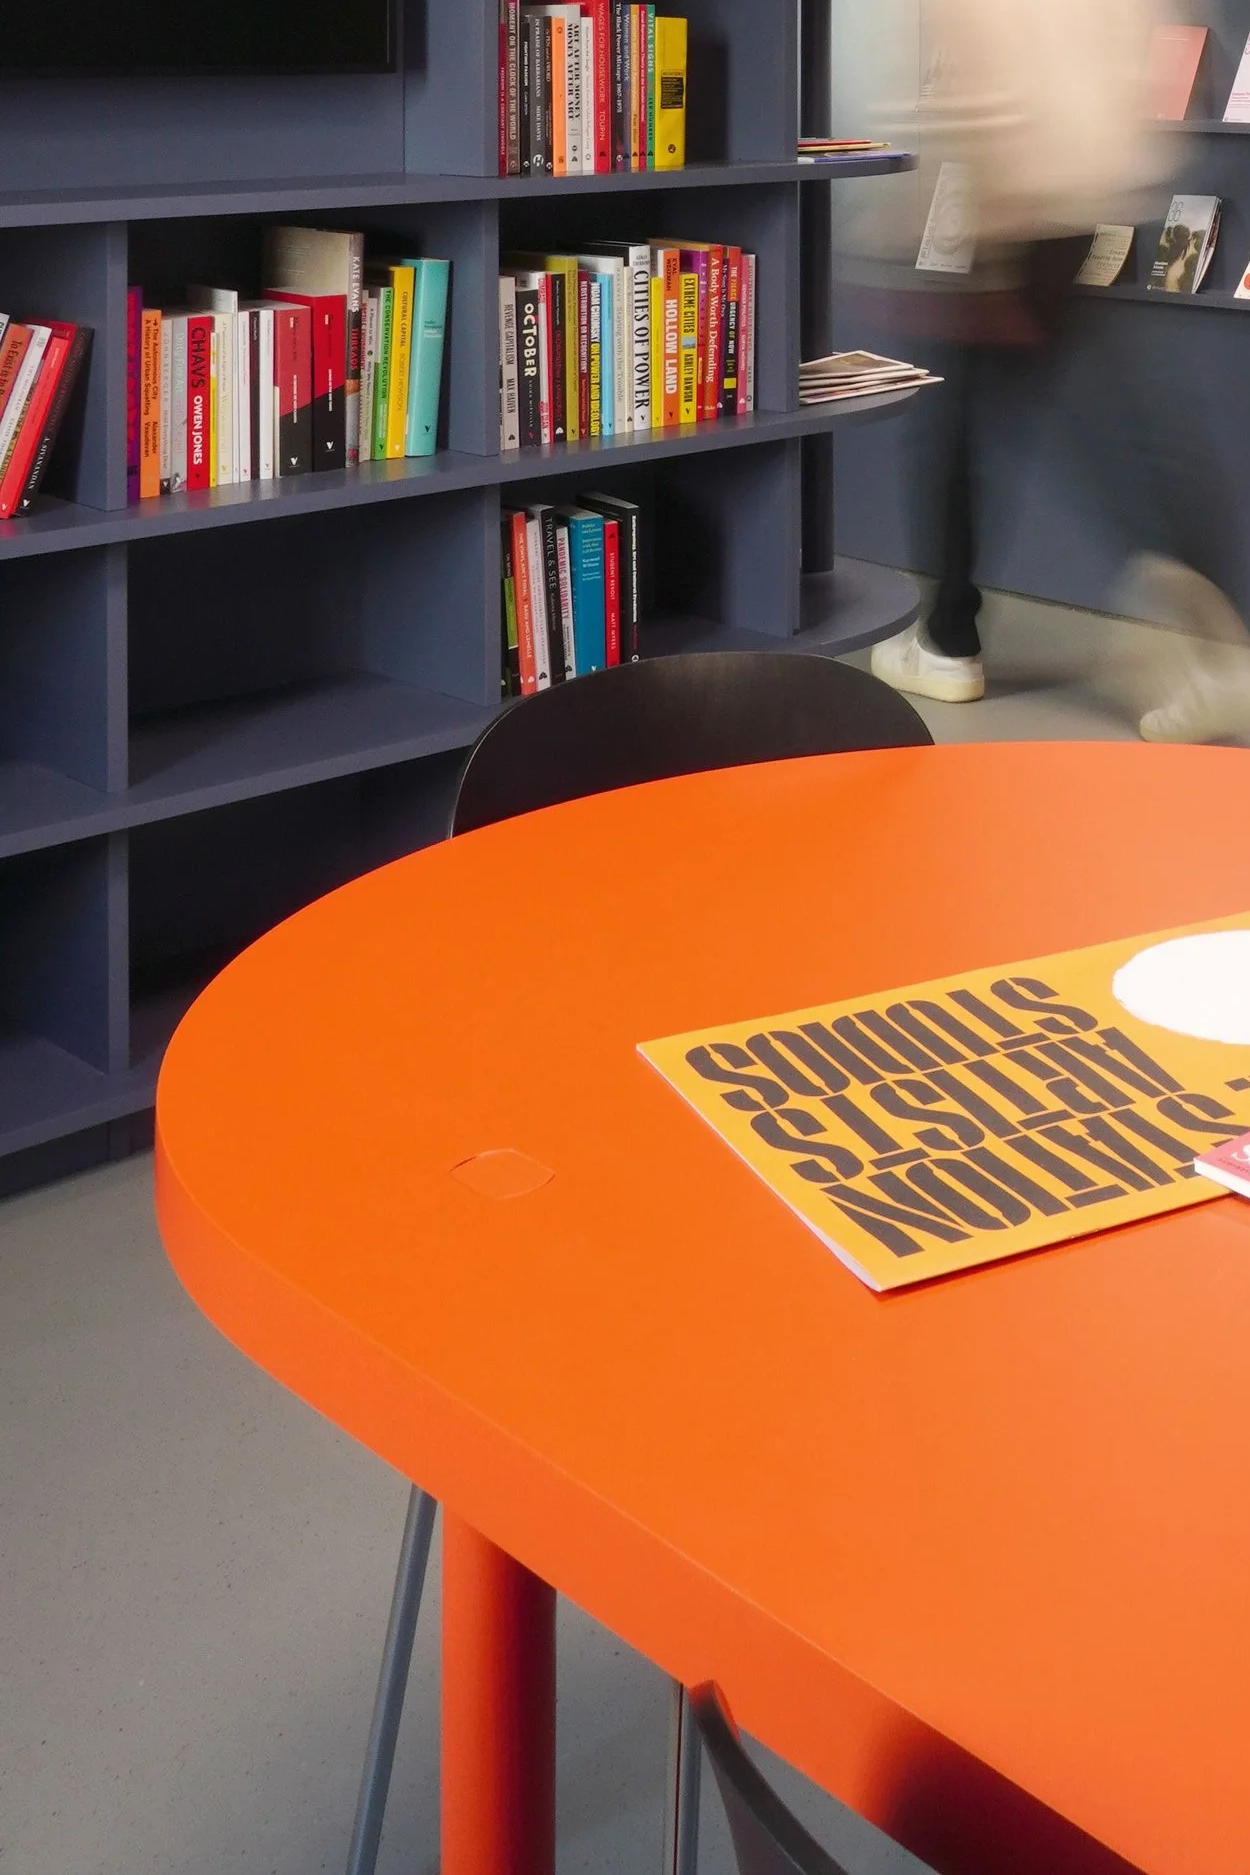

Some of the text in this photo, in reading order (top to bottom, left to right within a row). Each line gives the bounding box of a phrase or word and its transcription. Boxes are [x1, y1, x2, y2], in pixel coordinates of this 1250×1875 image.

[509, 1, 517, 141] MOMENT ON THE CLOCK OF THE WORLD
[535, 49, 541, 57] OF
[598, 3, 606, 141] WAGES FOR HOUSEWORK TOUPIN
[614, 3, 623, 81] The Black Power Mixtape
[580, 280, 588, 325] REDISTRIBUTION
[729, 278, 738, 302] FIERCE
[730, 265, 738, 277] THE
[10, 341, 24, 349] To
[350, 255, 360, 371] KATE EVANS THREADS
[383, 305, 392, 355] CONSERVATION
[399, 291, 409, 348] CULTURAL CAPITAL
[522, 303, 538, 377] OCTOBER
[580, 325, 588, 334] OR
[634, 270, 651, 410] CITIES OF POWER
[683, 277, 696, 403] EXTREME CITIES ASHLEY DAWSON
[706, 257, 720, 383] A Body Worth Defending
[728, 301, 737, 329] URGENCY
[728, 331, 736, 339] OF
[3, 349, 20, 369] Exist
[152, 328, 160, 399] The Autonomous City
[382, 357, 390, 399] REVOLUTION
[504, 304, 516, 414] REVENGE CAPITALISM MAX HAIVEN
[580, 334, 588, 374] RECOGNITION?
[590, 283, 601, 437] NOAM CHOMSKY ON POWER AND IDEOLOGY
[615, 307, 624, 403] Staying with the Trouble
[664, 299, 678, 395] HOLLOW LAND
[191, 327, 207, 465] CHAVS OWEN JONES
[27, 444, 48, 491] SIVANANDAN
[544, 517, 556, 590] TRAVEL & SEE
[558, 537, 569, 575] PANDEMIC
[523, 621, 531, 634] AND
[559, 577, 570, 621] SOLIDARITY
[524, 635, 533, 659] LEMELLE
[685, 976, 1099, 1112] STUDIOS
[750, 1025, 1187, 1185] ARTISTS
[823, 1092, 1236, 1258] STATION
